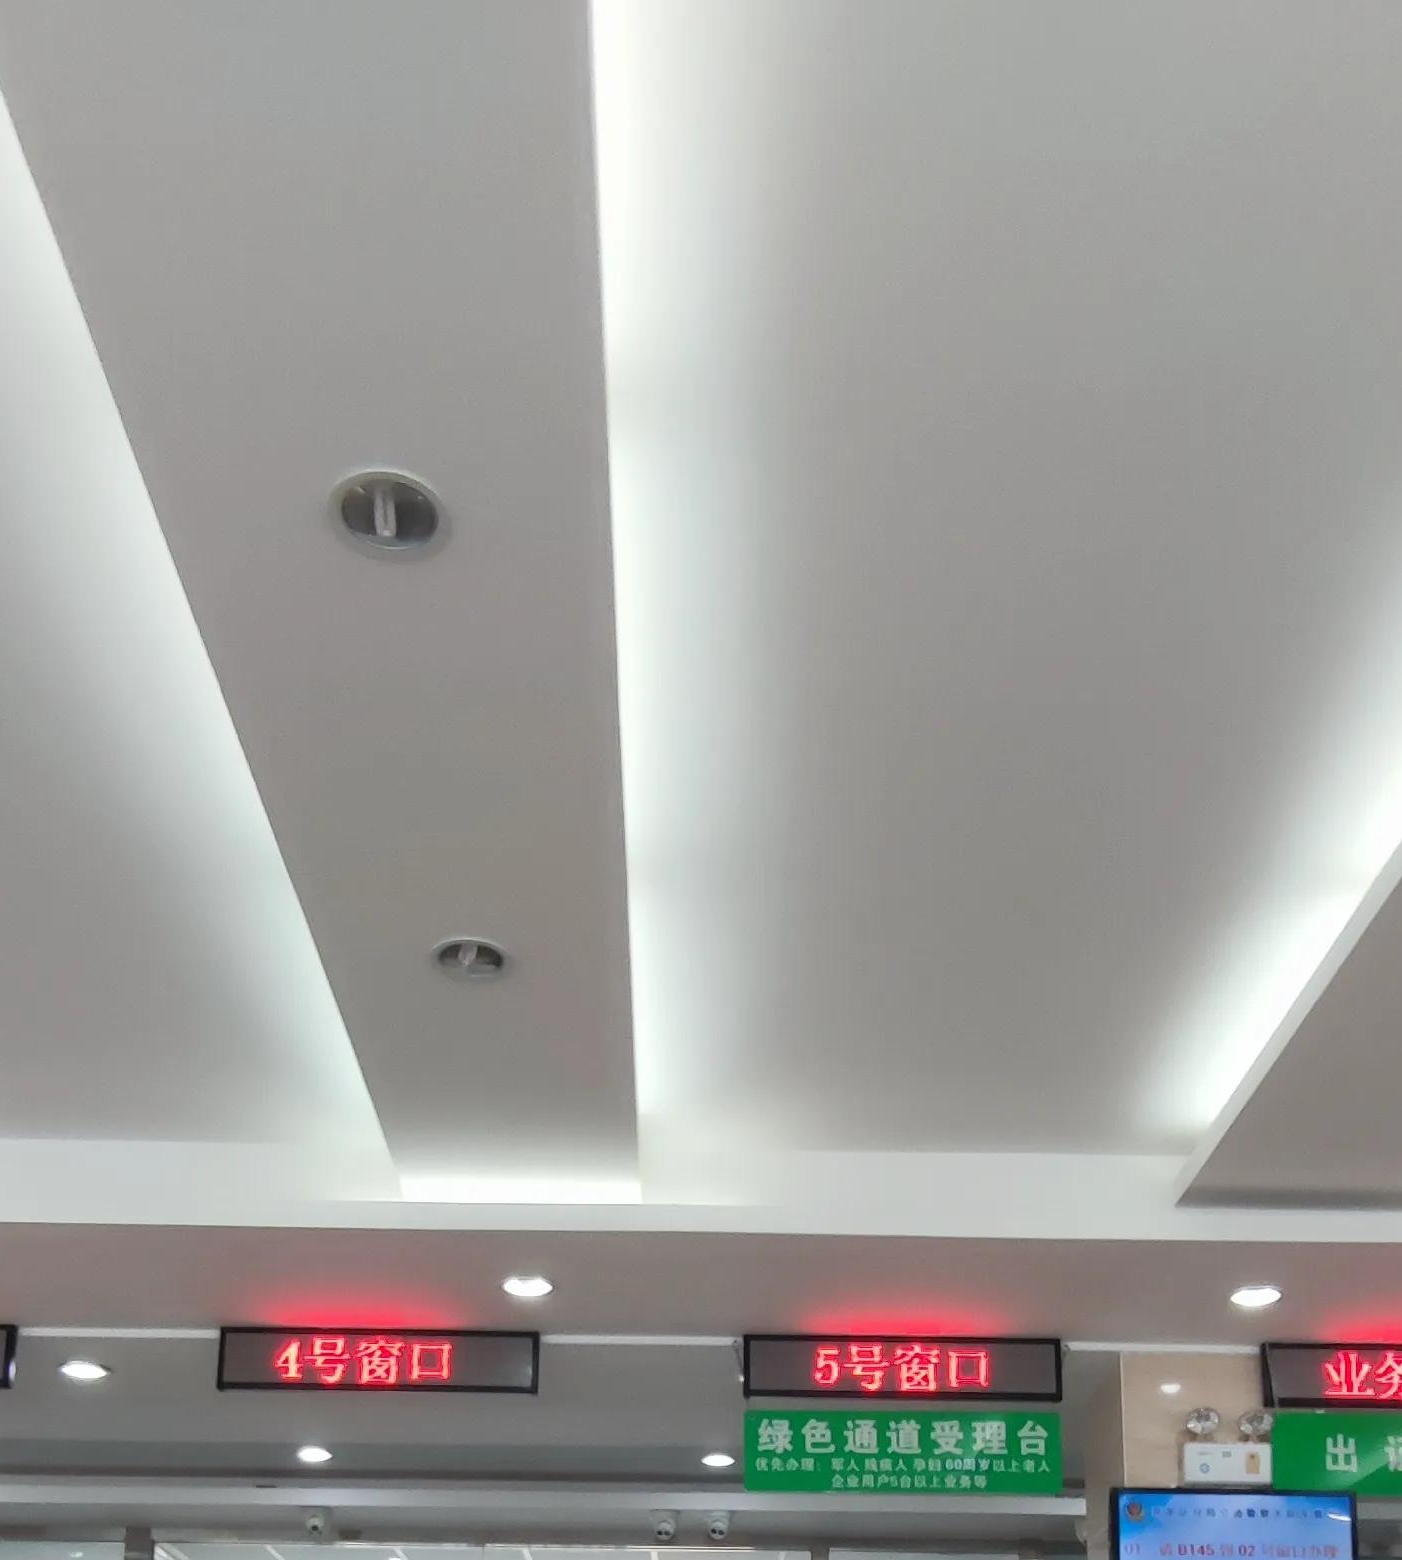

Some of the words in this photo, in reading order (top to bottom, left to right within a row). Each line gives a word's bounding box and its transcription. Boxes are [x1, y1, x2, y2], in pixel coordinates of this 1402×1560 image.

[275, 1336, 454, 1384] 4号窗口
[814, 1344, 991, 1392] 5号窗口
[757, 1418, 1048, 1455] 绿色通道受理台
